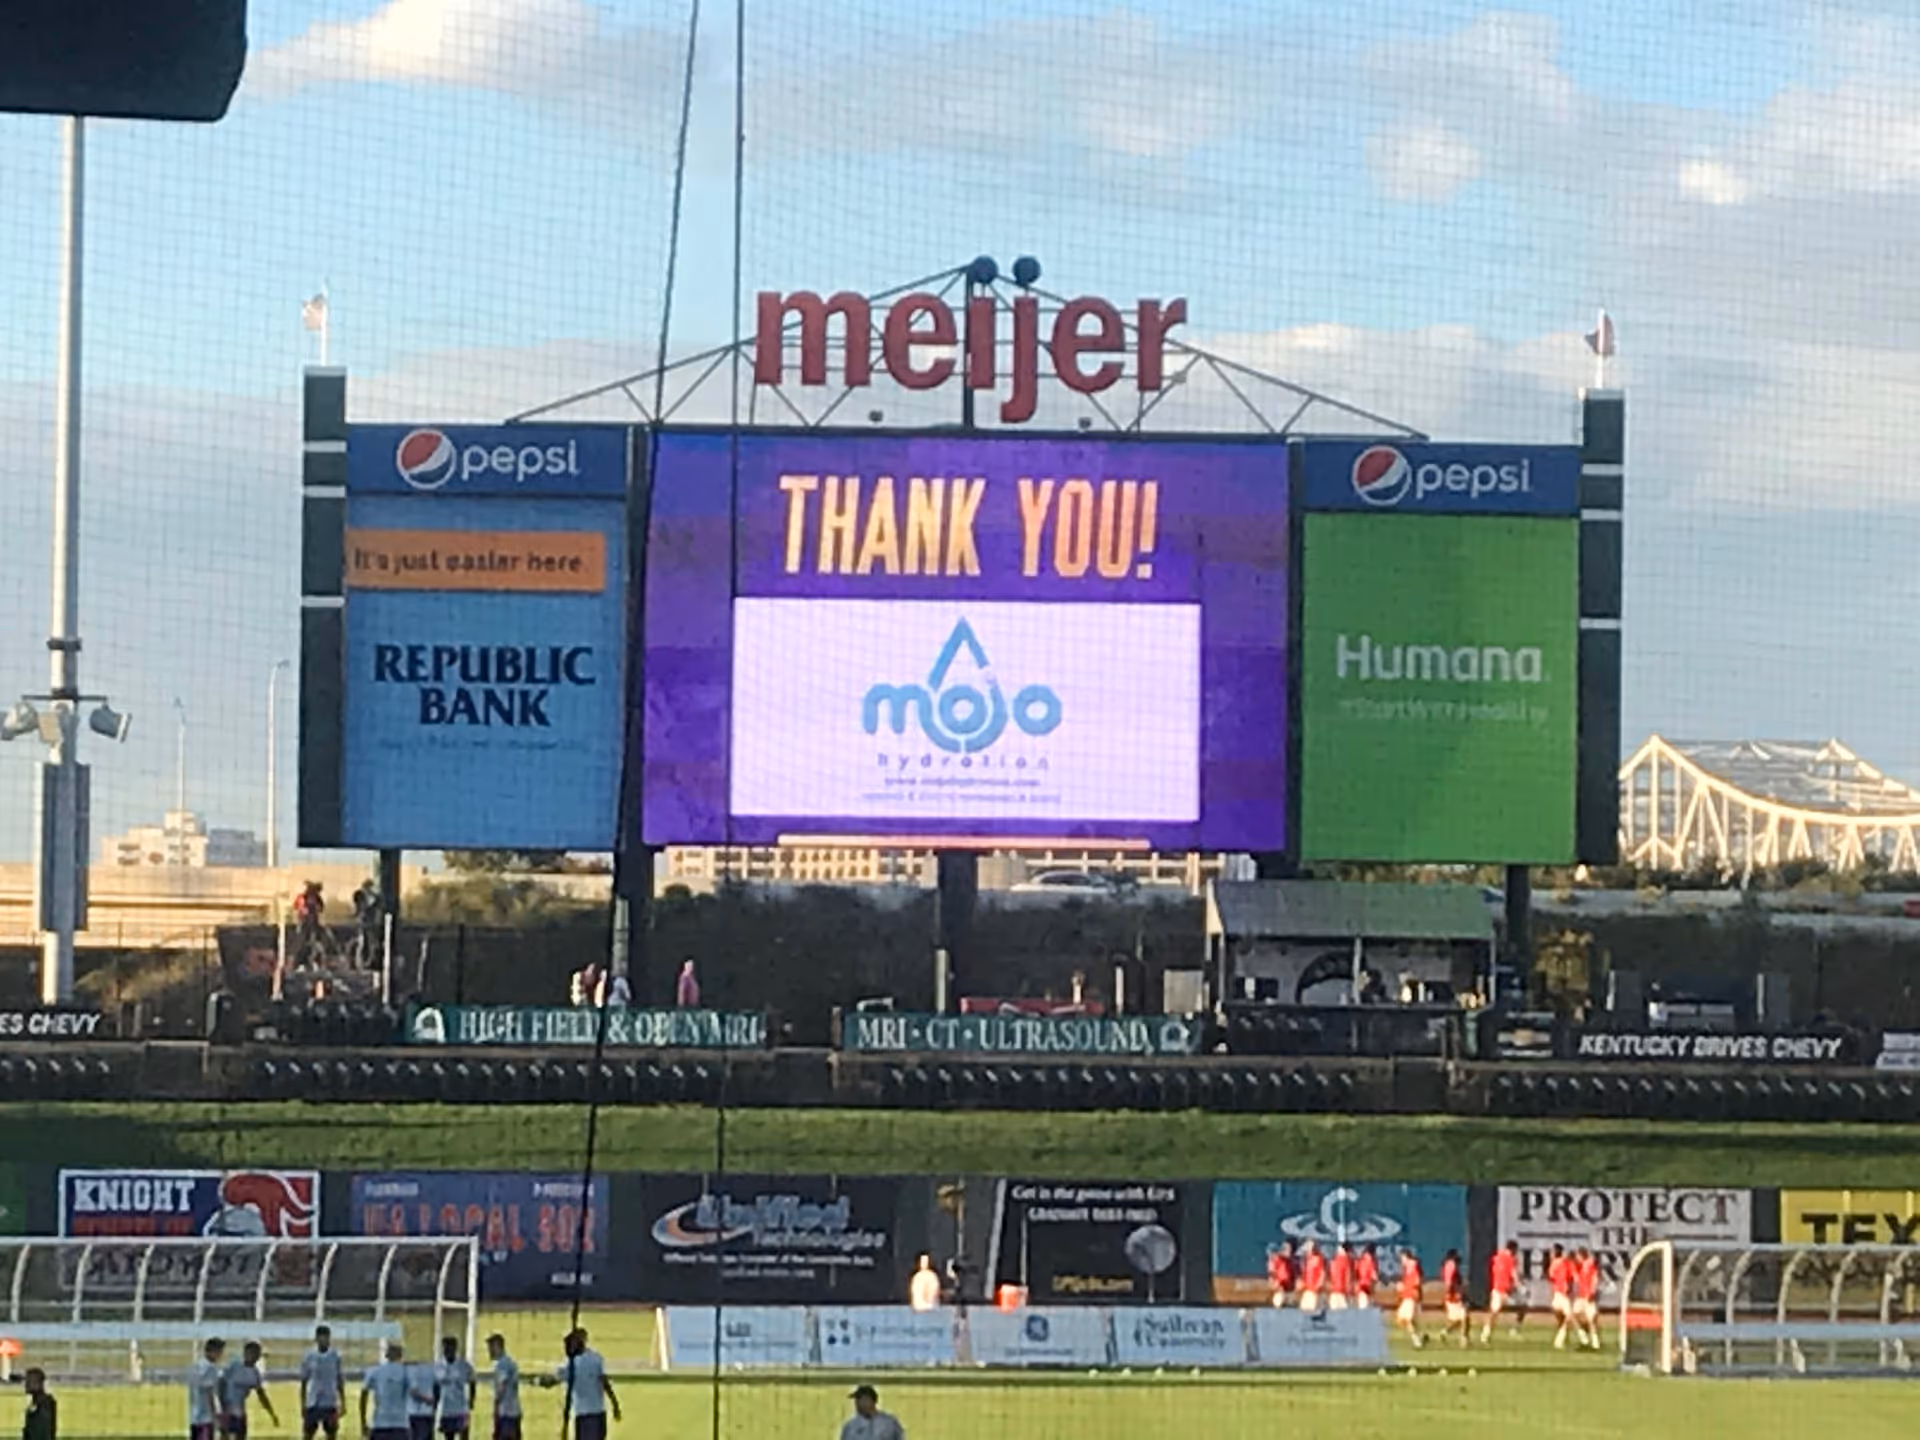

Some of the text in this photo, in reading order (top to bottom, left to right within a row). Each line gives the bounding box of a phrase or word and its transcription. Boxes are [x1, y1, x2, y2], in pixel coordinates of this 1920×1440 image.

[755, 258, 1188, 424] meijer
[460, 439, 580, 482] pepsi
[1415, 457, 1531, 500] pepsi
[778, 474, 1158, 580] THANK YOU!
[393, 549, 439, 575] just
[373, 643, 596, 686] REPUBLIC
[1336, 633, 1543, 683] Humana
[418, 687, 551, 727] BANK
[862, 683, 1062, 754] mojo
[28, 1011, 101, 1035] CHEVY
[607, 1010, 632, 1044] &
[857, 1017, 1148, 1053] MRI CT ULTRASOUND
[1578, 1034, 1841, 1058] KENTUCKY DRIVES CHEVY
[72, 1177, 196, 1212] KNIGHT
[1517, 1190, 1739, 1225] PROTECT
[1598, 1225, 1654, 1247] THE
